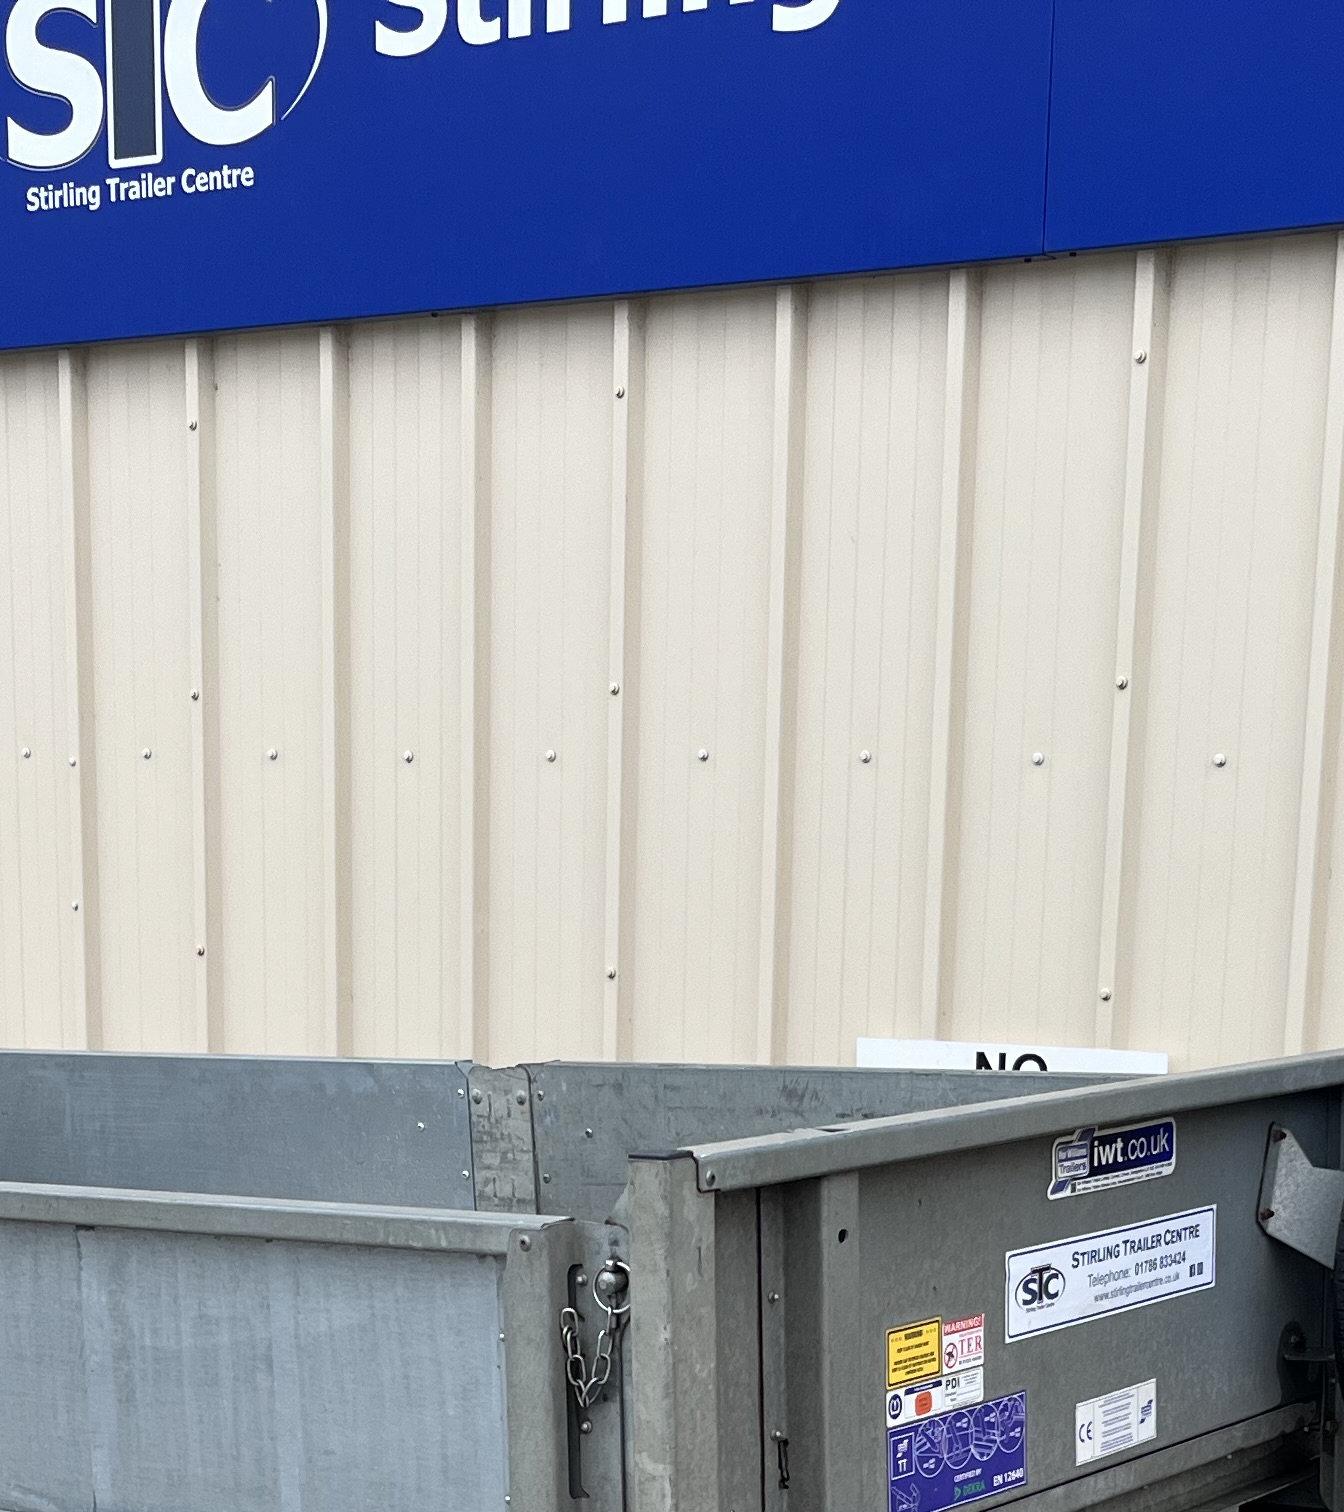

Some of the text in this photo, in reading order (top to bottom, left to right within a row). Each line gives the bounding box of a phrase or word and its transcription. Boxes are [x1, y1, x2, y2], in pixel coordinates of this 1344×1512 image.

[26, 165, 255, 212] Stirling Trailer Centre
[1093, 1127, 1170, 1167] iwt.co.uk
[1071, 1223, 1201, 1269] STIRLING TRAILER CENTRE
[1022, 1263, 1059, 1306] STC
[1088, 1267, 1131, 1288] Telephone:
